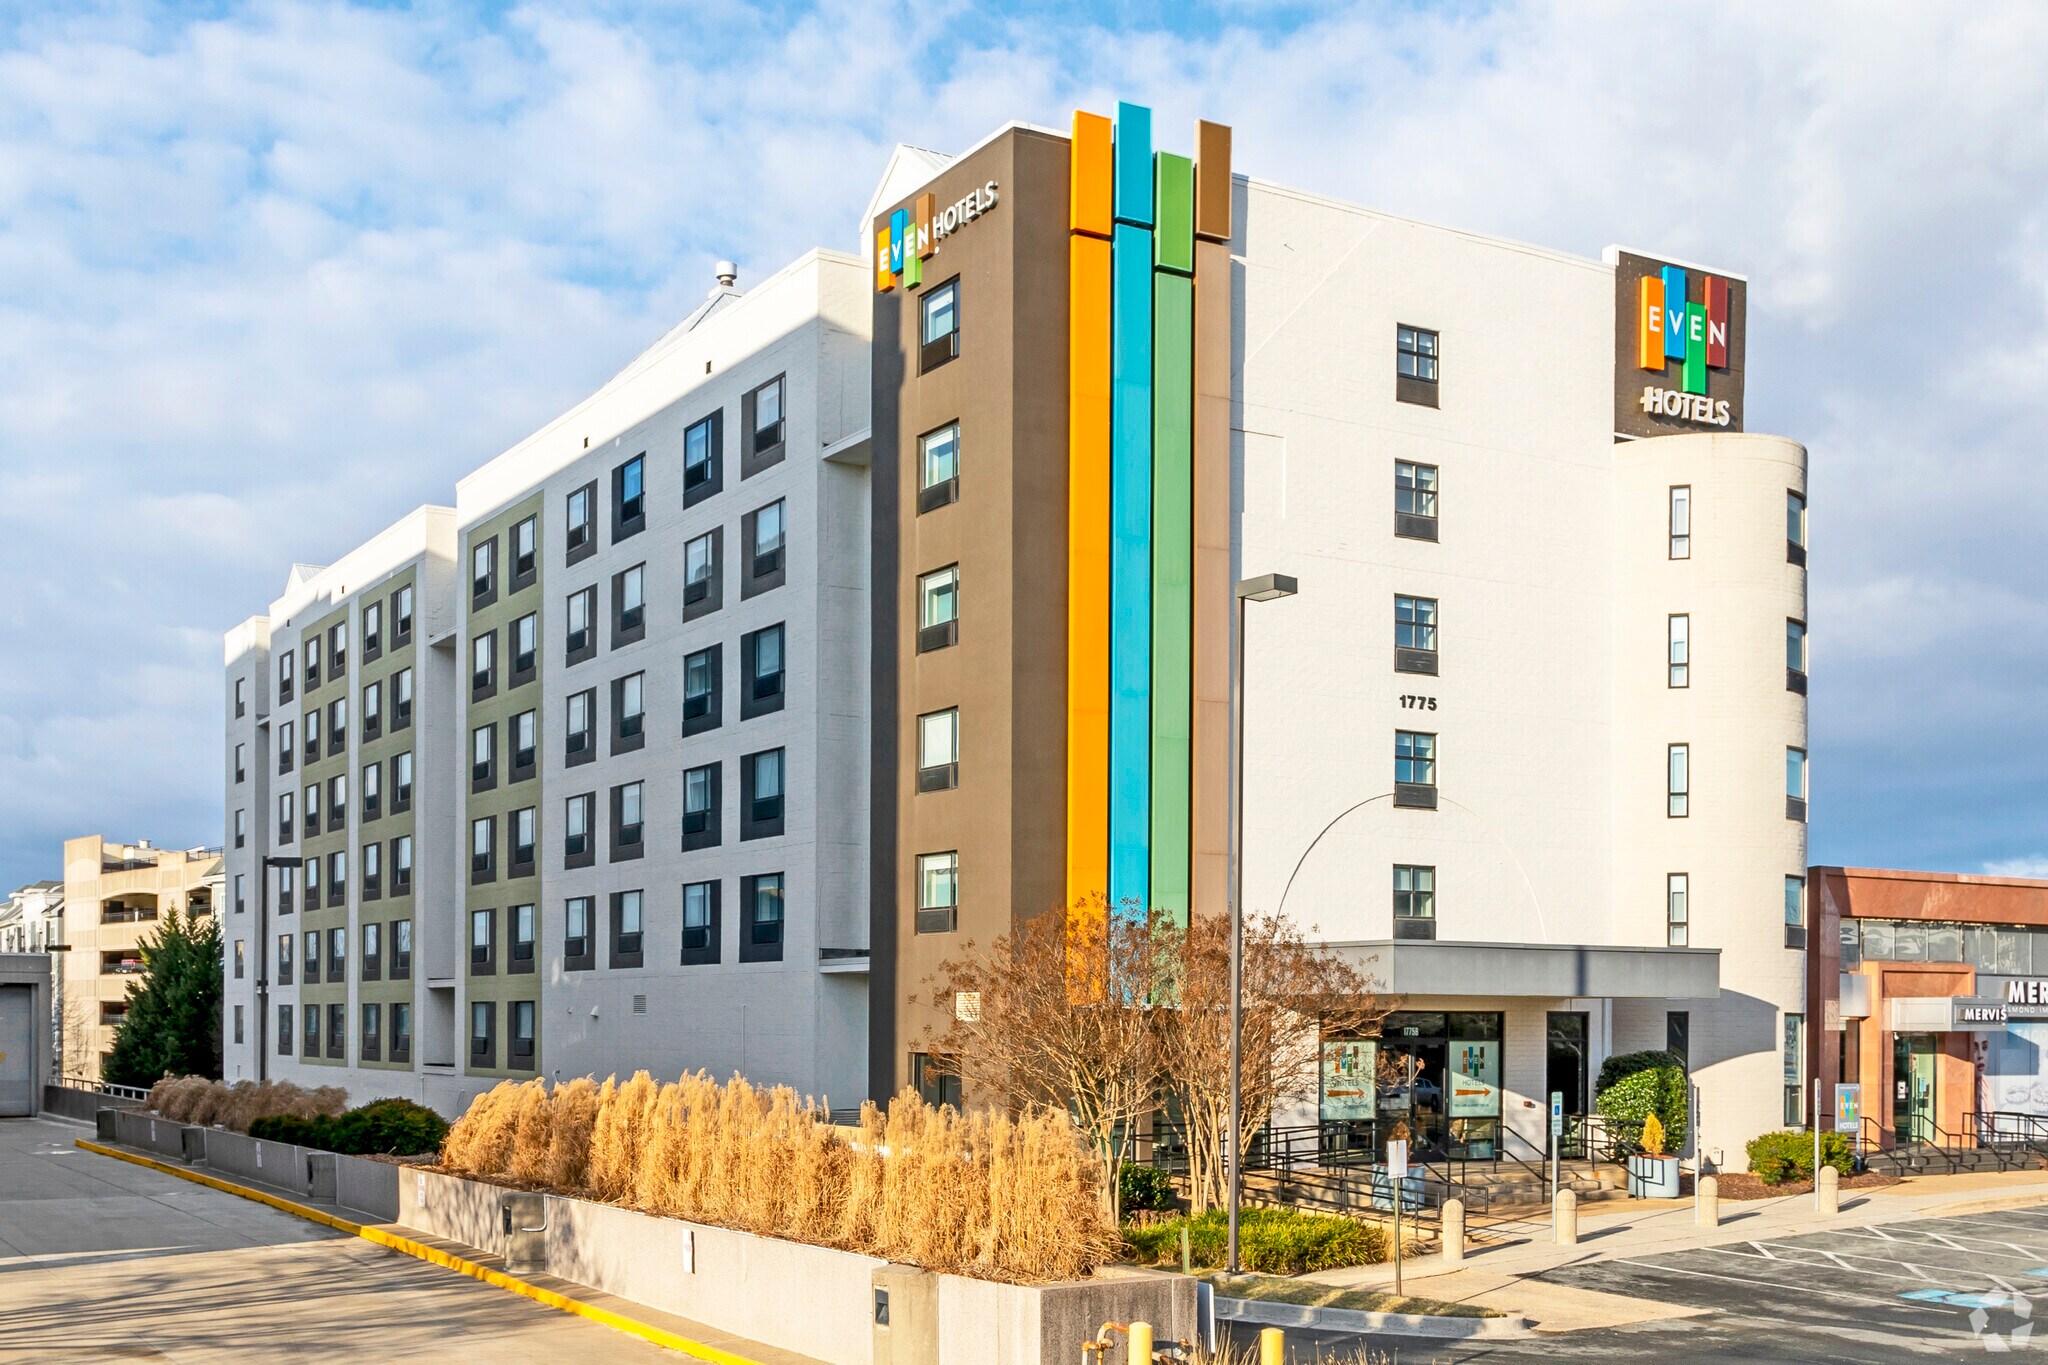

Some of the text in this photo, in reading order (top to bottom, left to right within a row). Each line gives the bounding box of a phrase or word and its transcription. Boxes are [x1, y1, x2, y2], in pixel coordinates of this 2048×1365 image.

[932, 180, 998, 240] HOTELS
[879, 223, 929, 272] EVEN
[1649, 306, 1726, 347] EVEN
[1640, 386, 1730, 426] HOTELS
[1399, 694, 1437, 711] 1775
[1964, 1008, 2007, 1021] MERVIS
